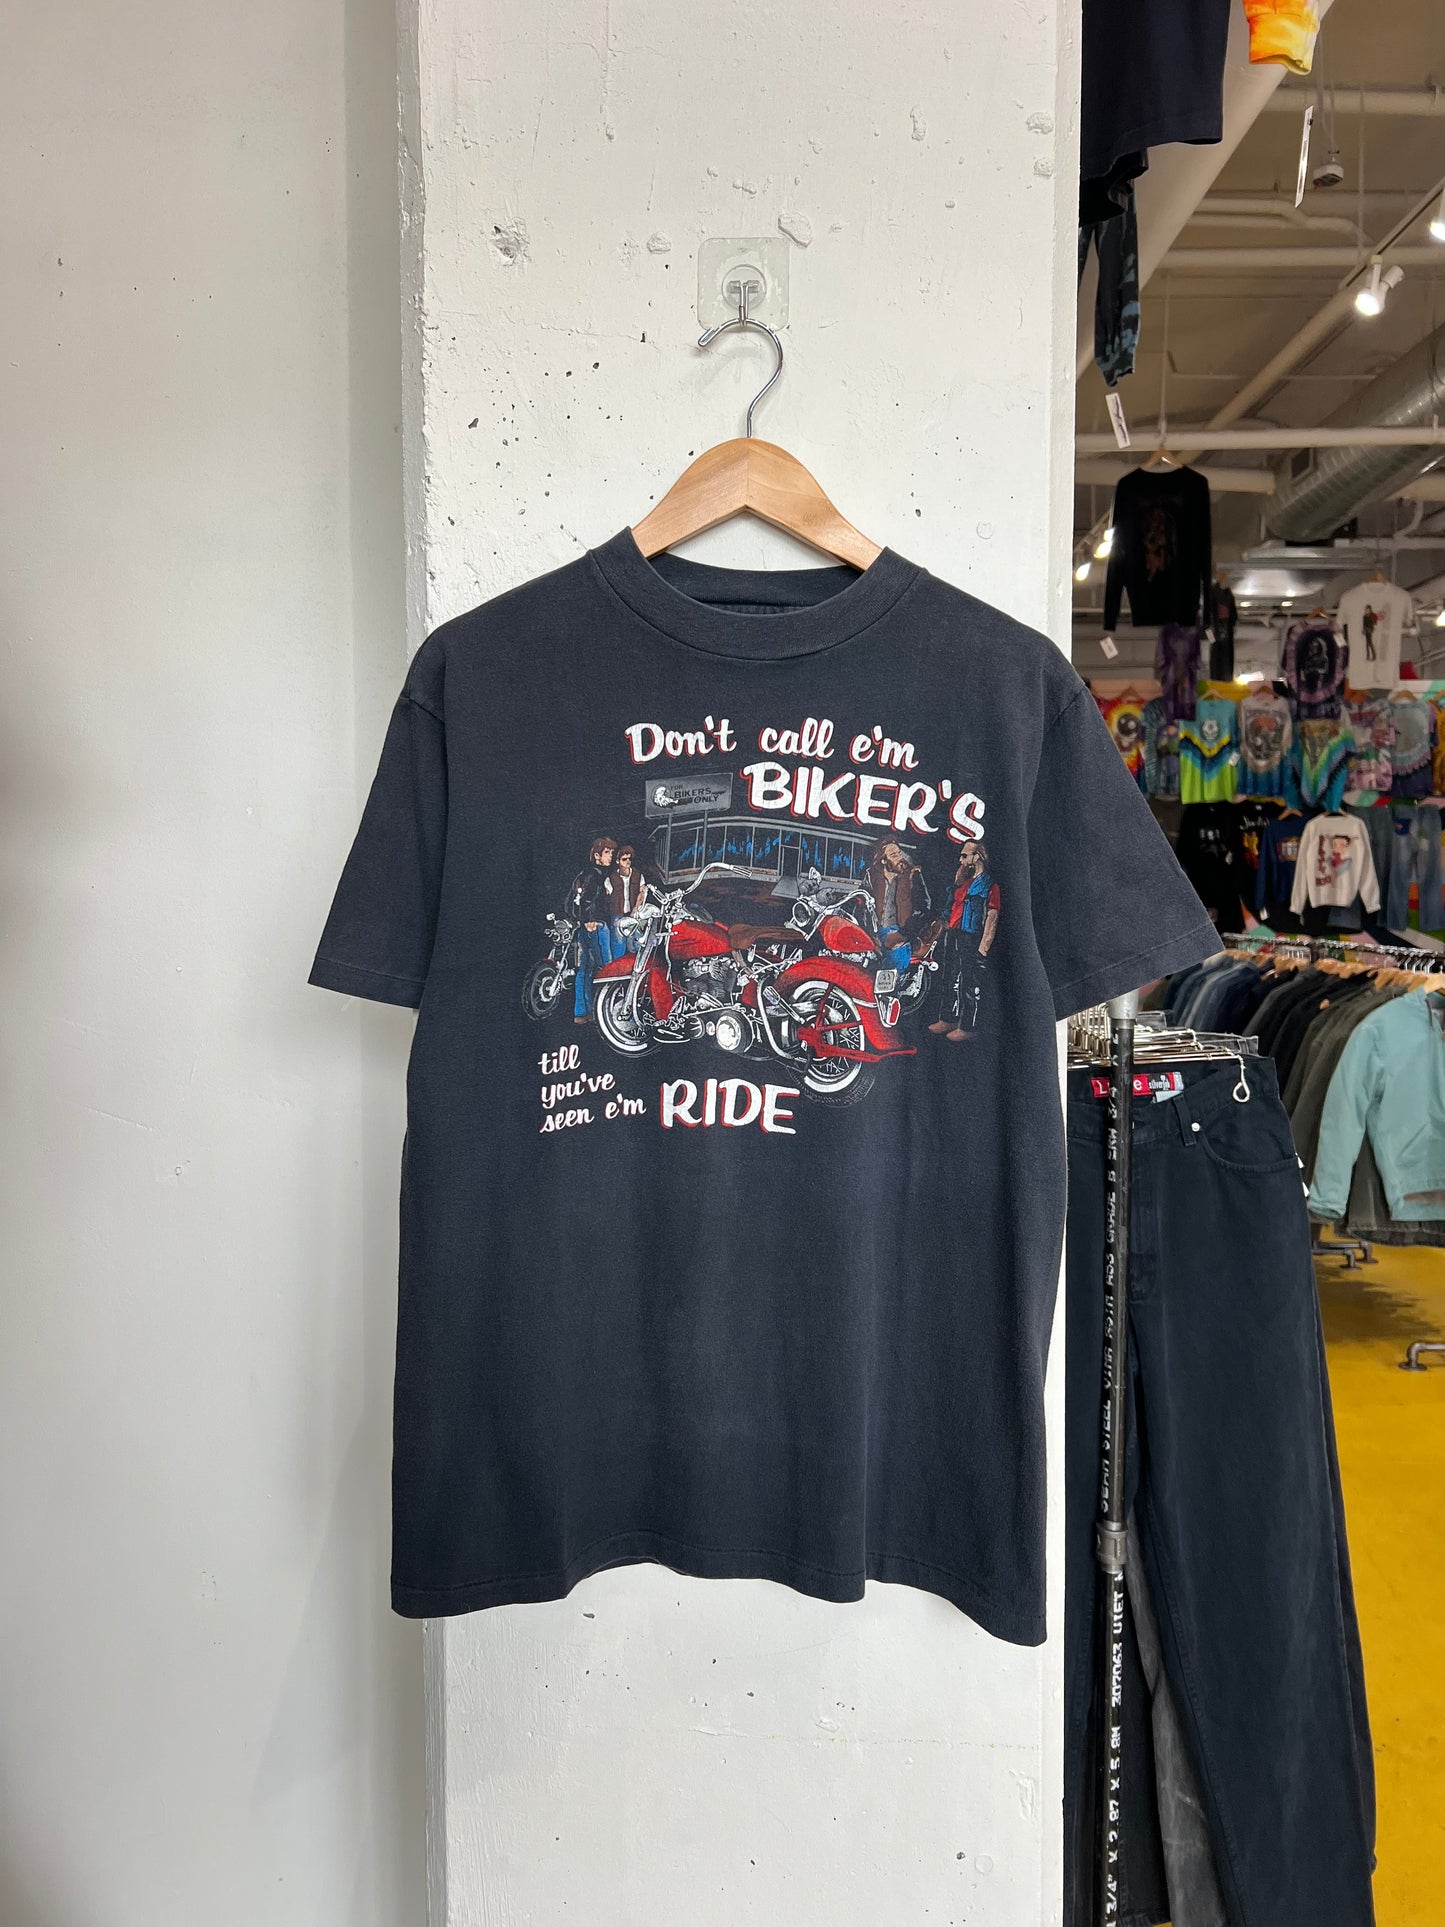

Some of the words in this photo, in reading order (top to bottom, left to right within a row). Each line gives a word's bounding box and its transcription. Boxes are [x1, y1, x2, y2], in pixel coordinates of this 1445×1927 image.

[624, 715, 737, 764] Don't
[758, 717, 835, 760] call
[849, 723, 919, 771] e'm
[674, 787, 712, 799] BIKERS
[694, 794, 719, 804] ONLY
[739, 761, 986, 844] BIKER'S
[538, 1044, 581, 1075] till
[539, 1107, 594, 1134] seen
[604, 1092, 646, 1120] e'm
[660, 1078, 800, 1135] RIDE
[541, 1072, 615, 1109] you've
[1102, 1400, 1111, 1450] STEEL
[1109, 1778, 1120, 1791] X
[1108, 1850, 1118, 1863] X
